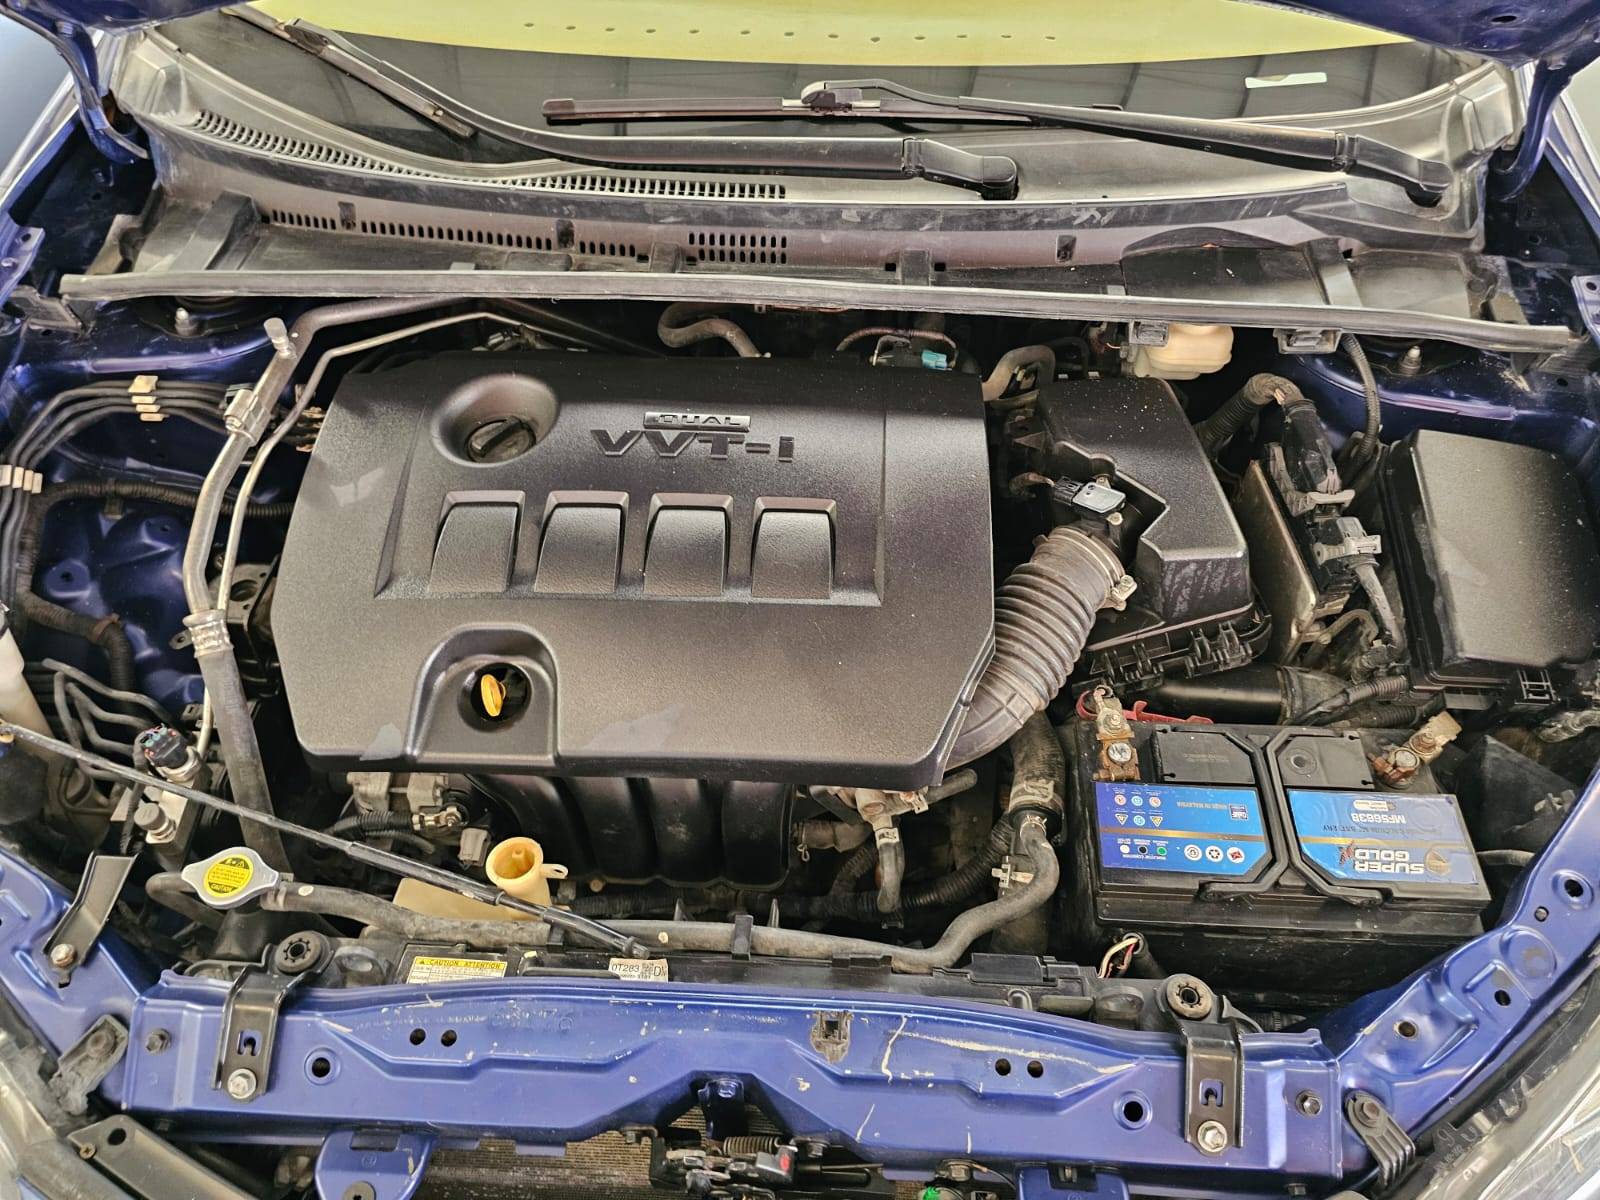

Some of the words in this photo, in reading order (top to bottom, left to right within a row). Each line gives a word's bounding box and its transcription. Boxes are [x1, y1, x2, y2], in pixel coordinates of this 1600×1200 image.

[658, 414, 741, 426] DUAL
[1354, 848, 1410, 862] GOLD
[1354, 862, 1425, 875] SUPER
[429, 959, 459, 967] CAUTION
[463, 961, 502, 969] ATTENTION
